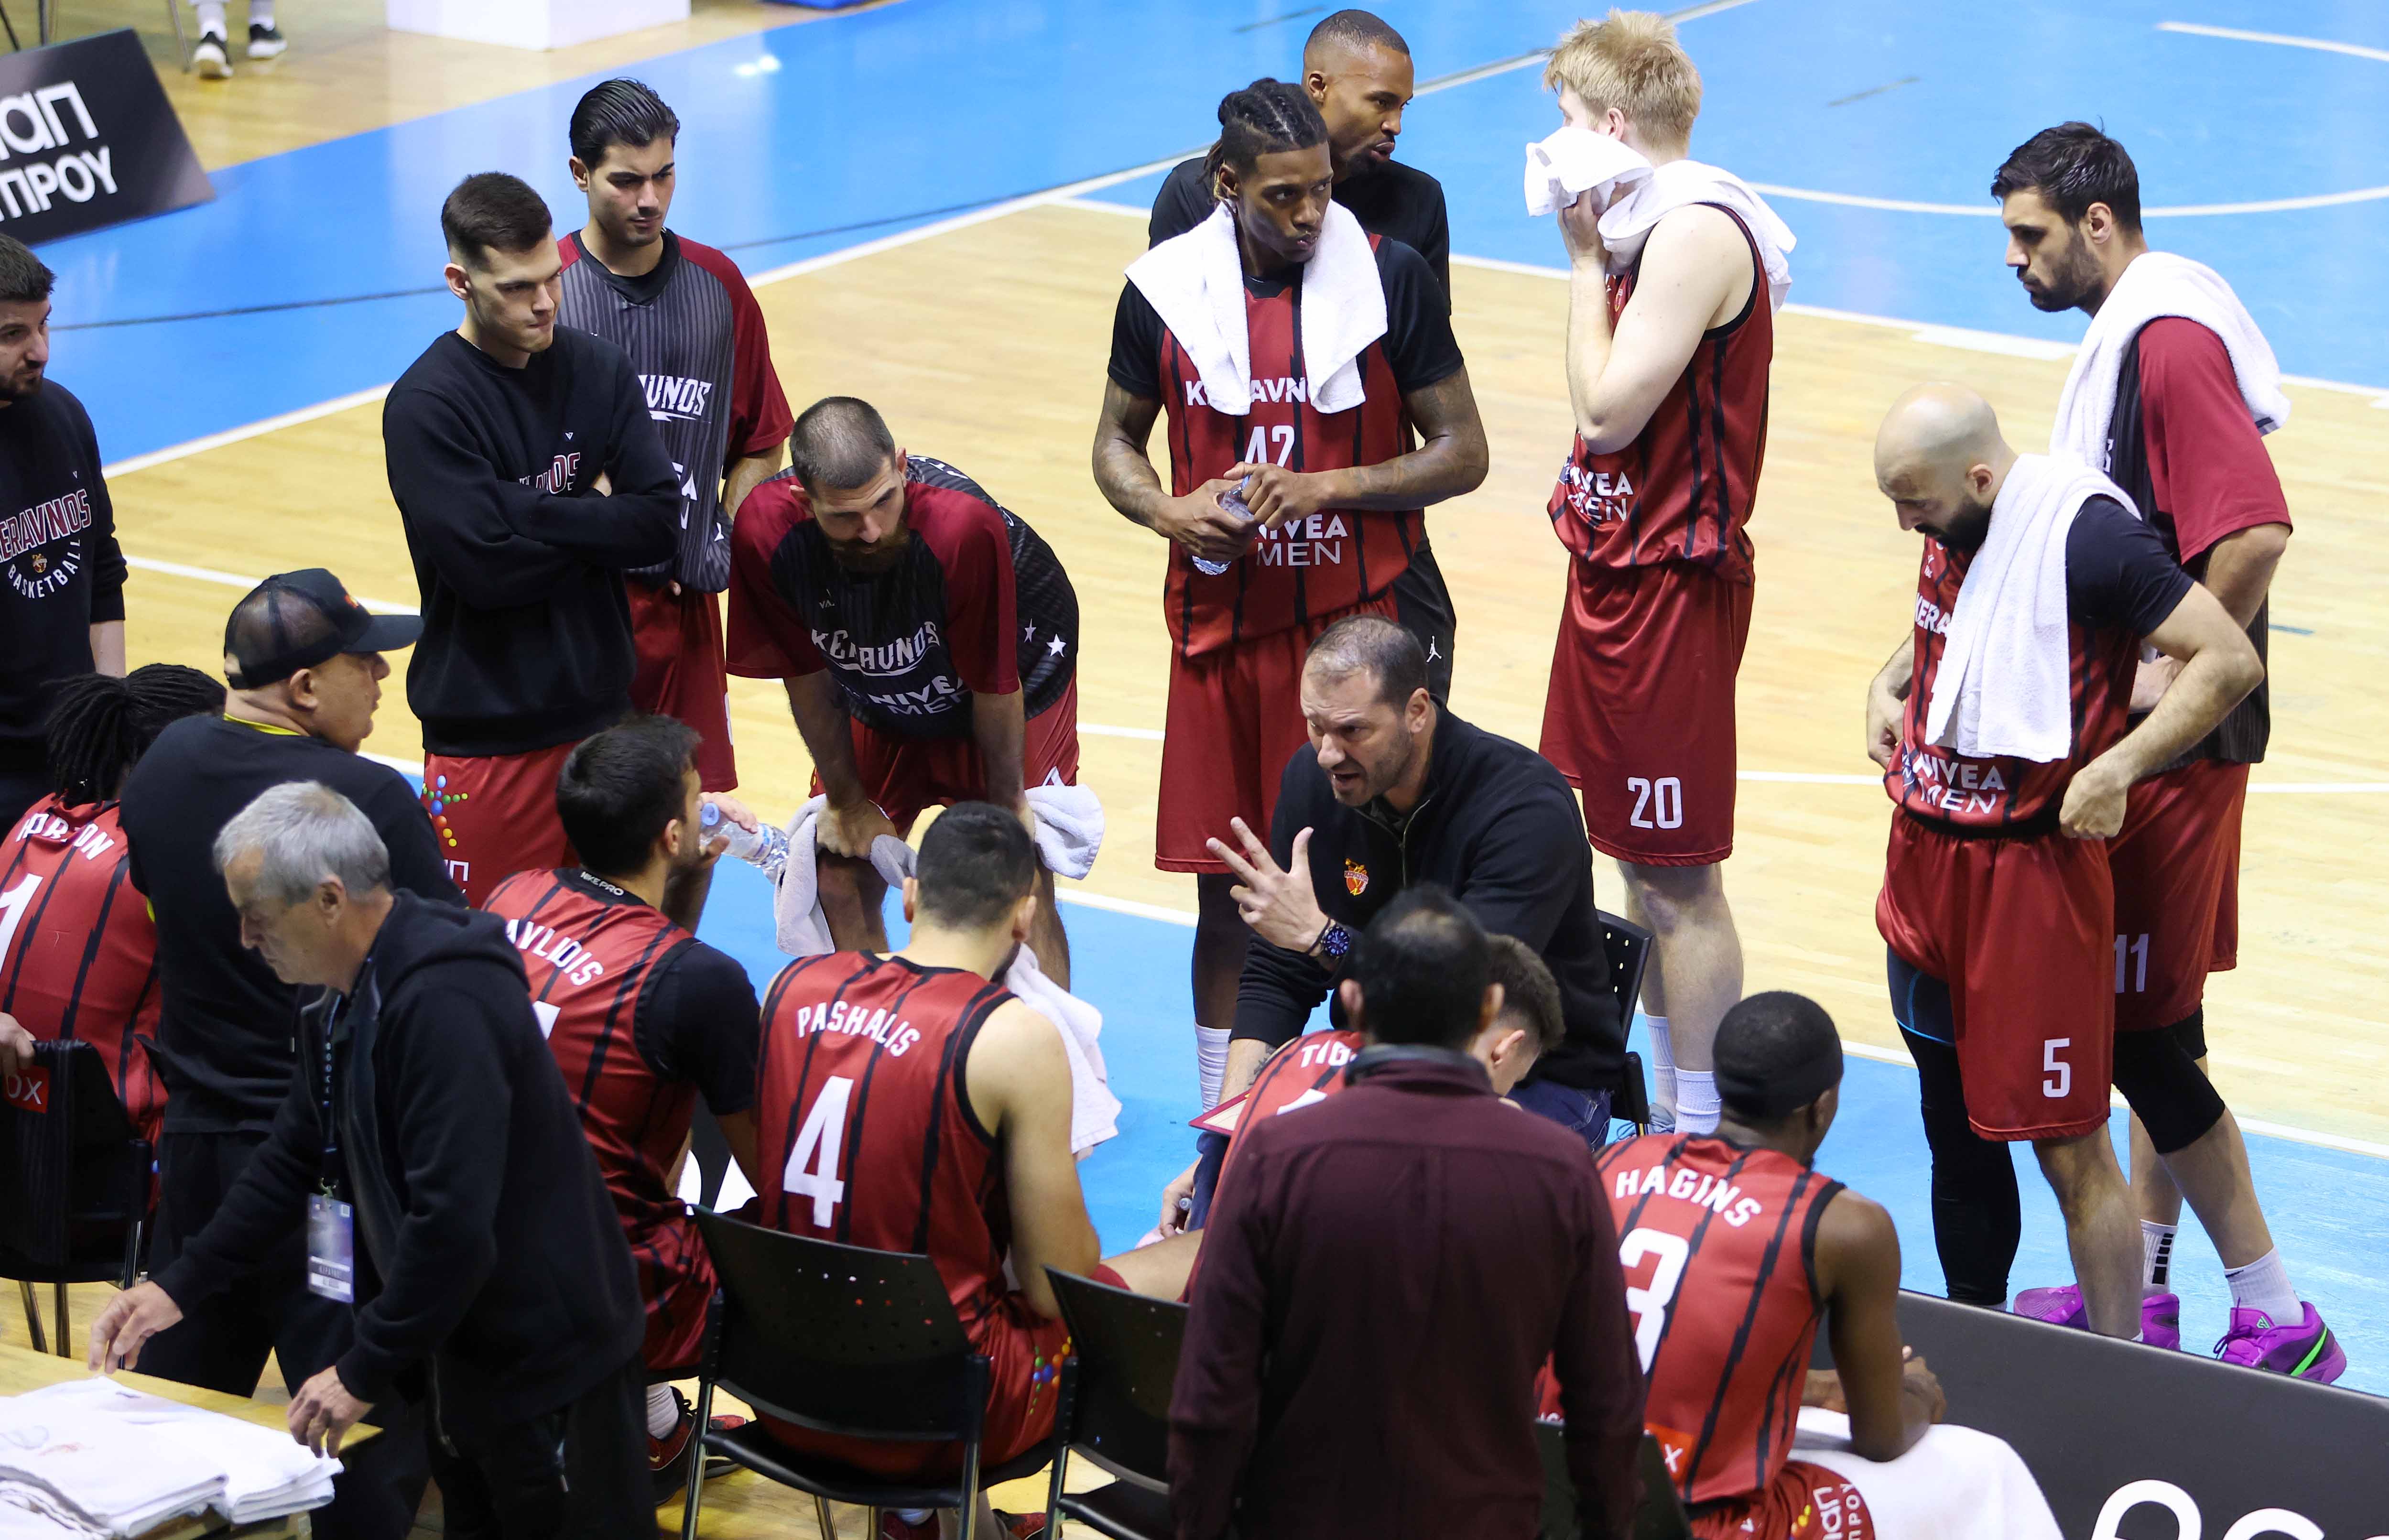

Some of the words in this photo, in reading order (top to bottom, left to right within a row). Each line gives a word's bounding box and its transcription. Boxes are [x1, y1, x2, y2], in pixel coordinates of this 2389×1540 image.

[0, 145, 119, 221] ΠΡΟΥ
[638, 374, 712, 416] UNOS
[1185, 377, 1309, 406] KAVN
[1244, 425, 1295, 467] 42
[0, 488, 91, 563] ERAVNOS
[8, 539, 81, 599] BASKETBALL
[1256, 541, 1341, 566] MEN
[1915, 593, 1951, 636] KERA
[1912, 751, 2006, 790] NIVEA
[1918, 778, 1997, 814] MEN
[1627, 777, 1683, 829] 20
[580, 871, 601, 885] NIKE
[598, 881, 624, 896] PRO
[506, 919, 604, 986] AVLIDIS
[2114, 933, 2149, 993] 11
[798, 1001, 921, 1057] PASHALIS
[1301, 1040, 1357, 1068] TIG
[2042, 1037, 2071, 1098] 5
[783, 1075, 855, 1228] 4
[1615, 1165, 1763, 1227] HAGINS
[1619, 1227, 1689, 1375] 3
